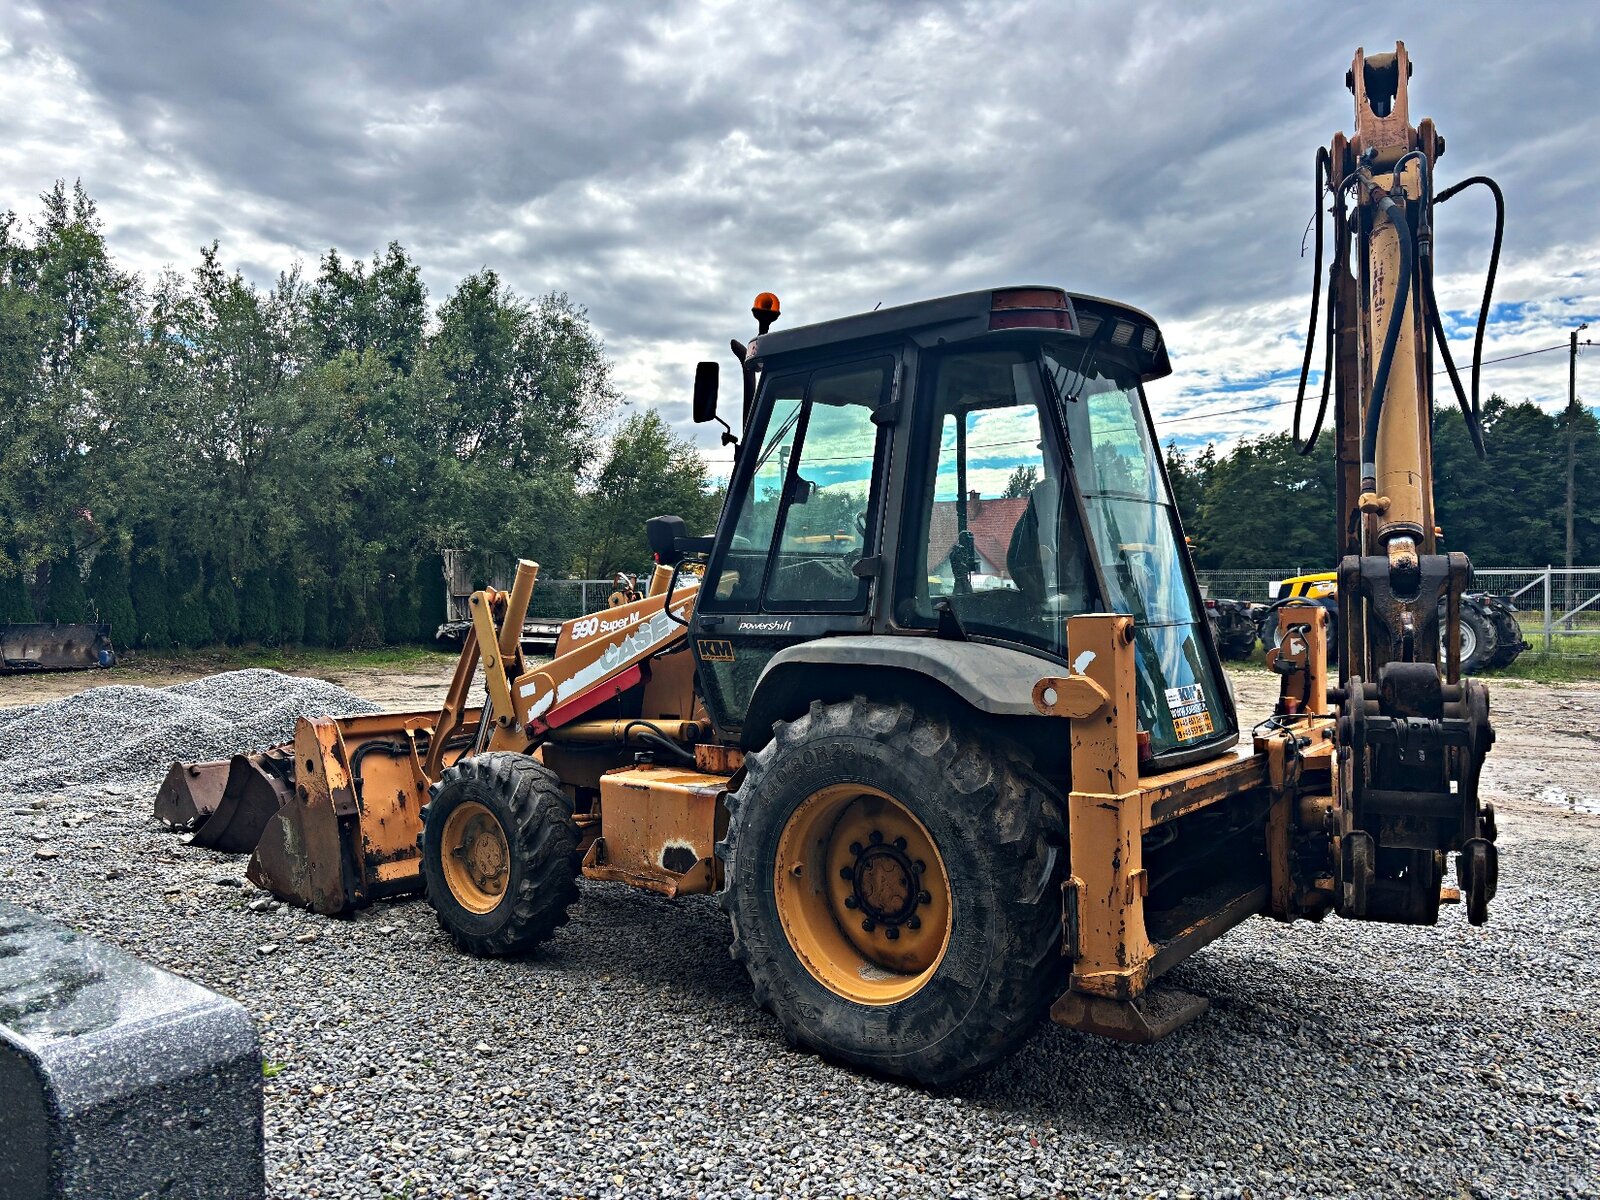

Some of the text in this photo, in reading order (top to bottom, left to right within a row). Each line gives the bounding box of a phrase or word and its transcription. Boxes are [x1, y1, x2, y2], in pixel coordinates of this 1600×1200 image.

[571, 611, 640, 640] 590 Super M
[739, 621, 792, 631] powershift
[600, 611, 669, 671] CASE
[699, 641, 733, 657] KM
